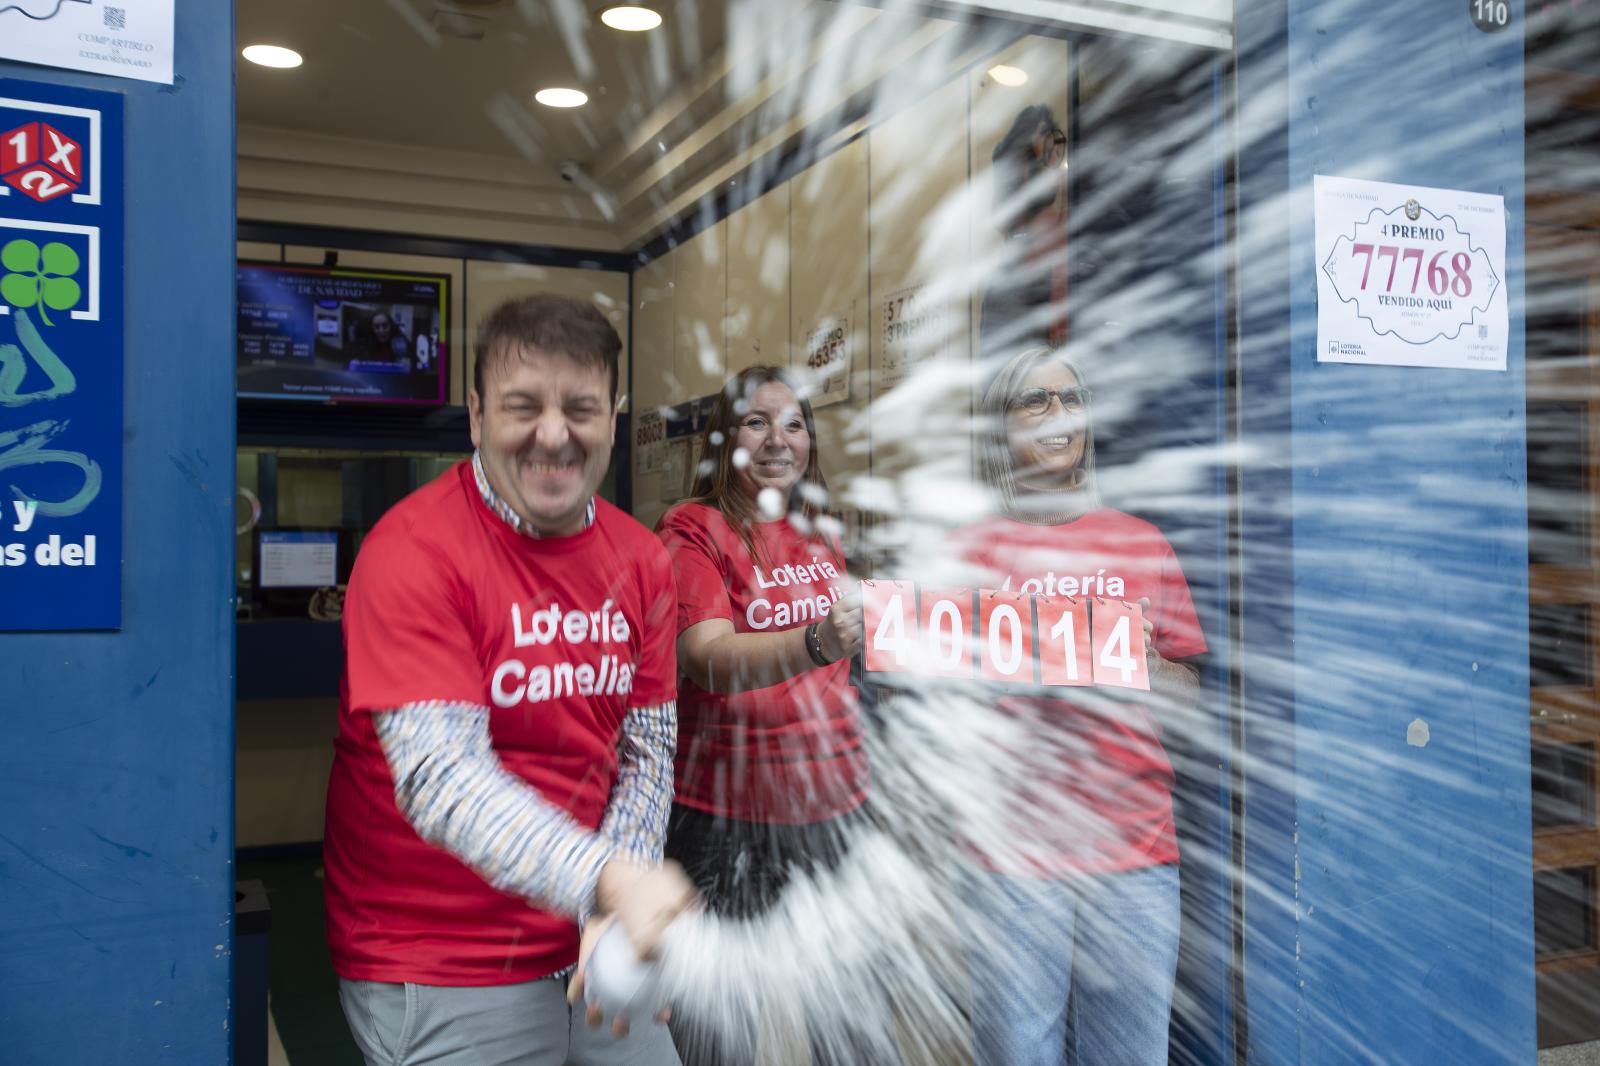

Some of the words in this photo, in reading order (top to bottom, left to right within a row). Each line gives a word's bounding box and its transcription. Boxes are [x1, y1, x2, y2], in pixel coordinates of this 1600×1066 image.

[1474, 0, 1508, 25] 110
[1391, 224, 1445, 241] PREMIO
[1352, 243, 1473, 298] 77768
[1378, 295, 1424, 308] VENDIDO
[12, 500, 39, 532] y
[34, 534, 97, 567] del
[752, 556, 840, 589] Lotería
[511, 599, 631, 648] Lotería
[873, 594, 1137, 683] 40014
